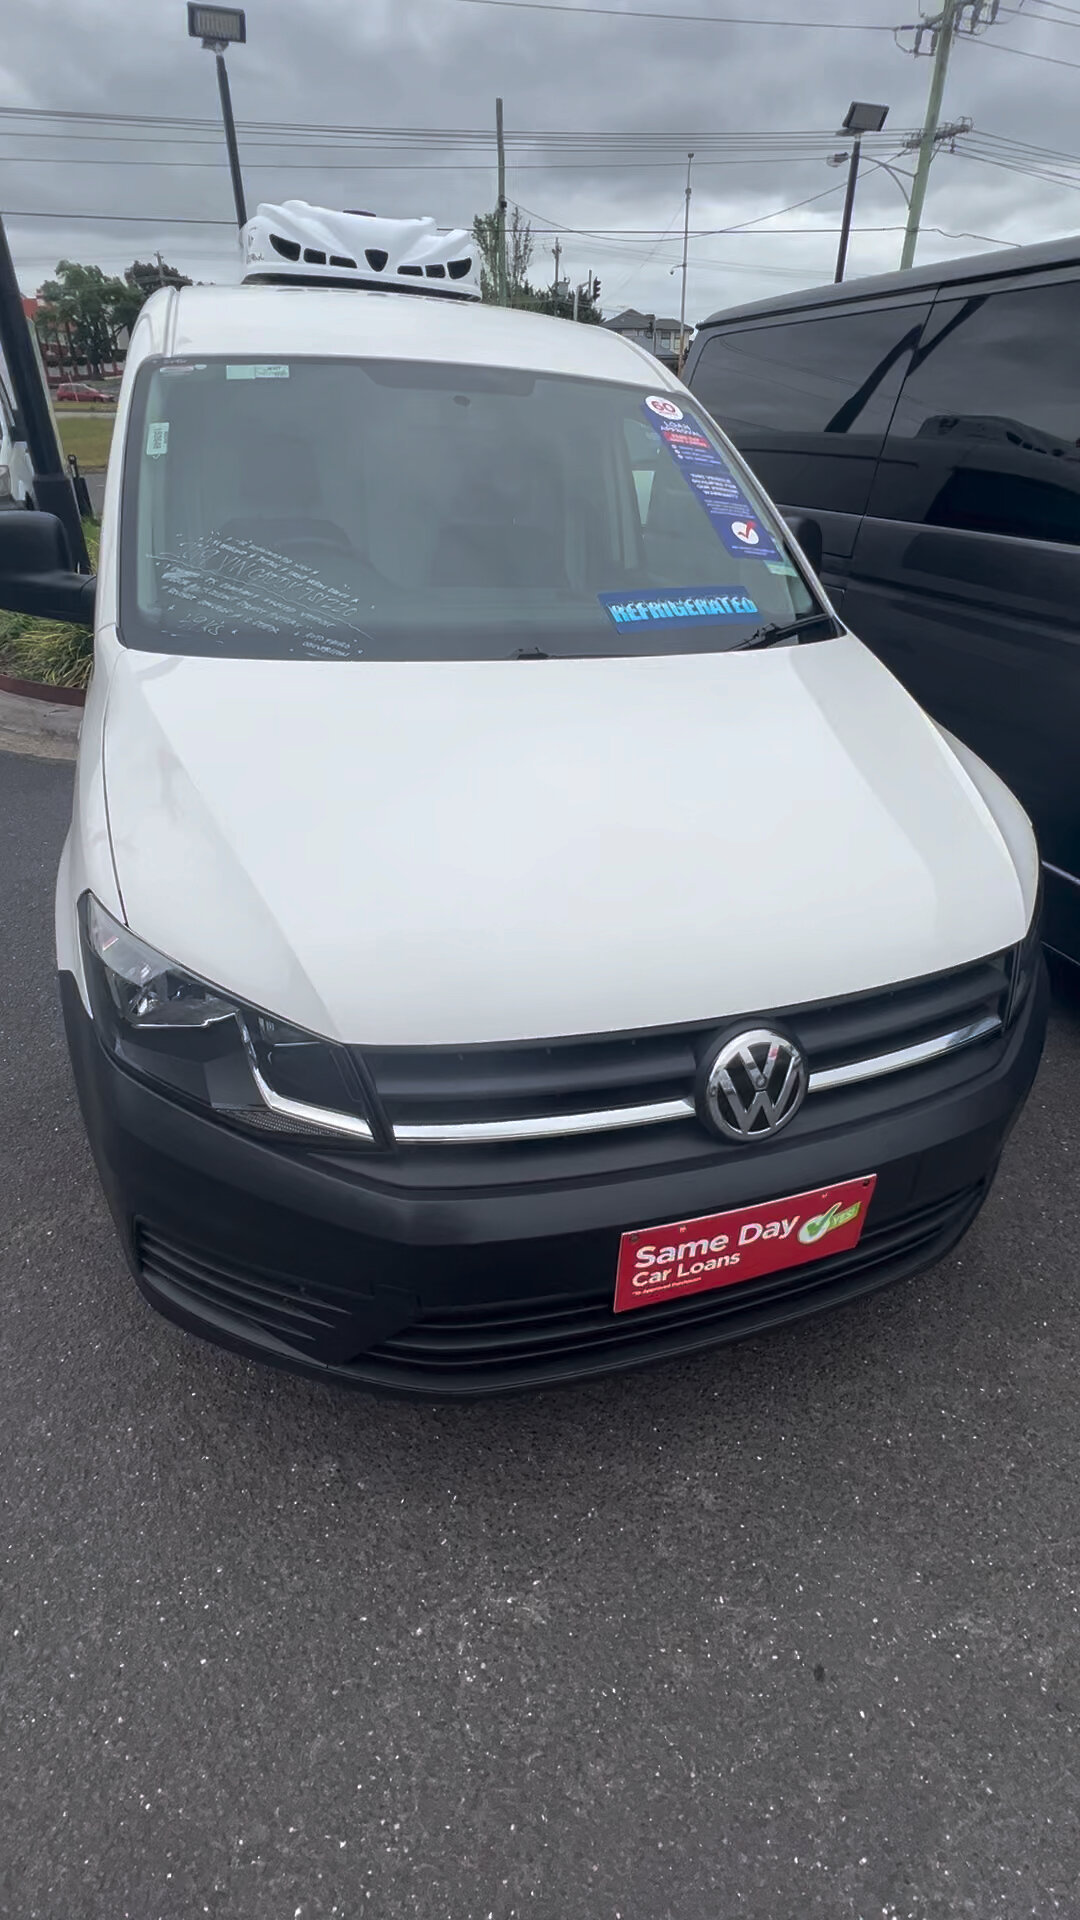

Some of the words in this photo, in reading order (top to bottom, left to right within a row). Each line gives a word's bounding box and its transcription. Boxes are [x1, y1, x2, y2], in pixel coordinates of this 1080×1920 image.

[650, 400, 676, 413] 60
[607, 596, 759, 623] REFRIGERATED
[634, 1234, 729, 1268] Same
[737, 1215, 801, 1247] Day
[632, 1268, 673, 1287] Car
[676, 1252, 741, 1278] Loans
